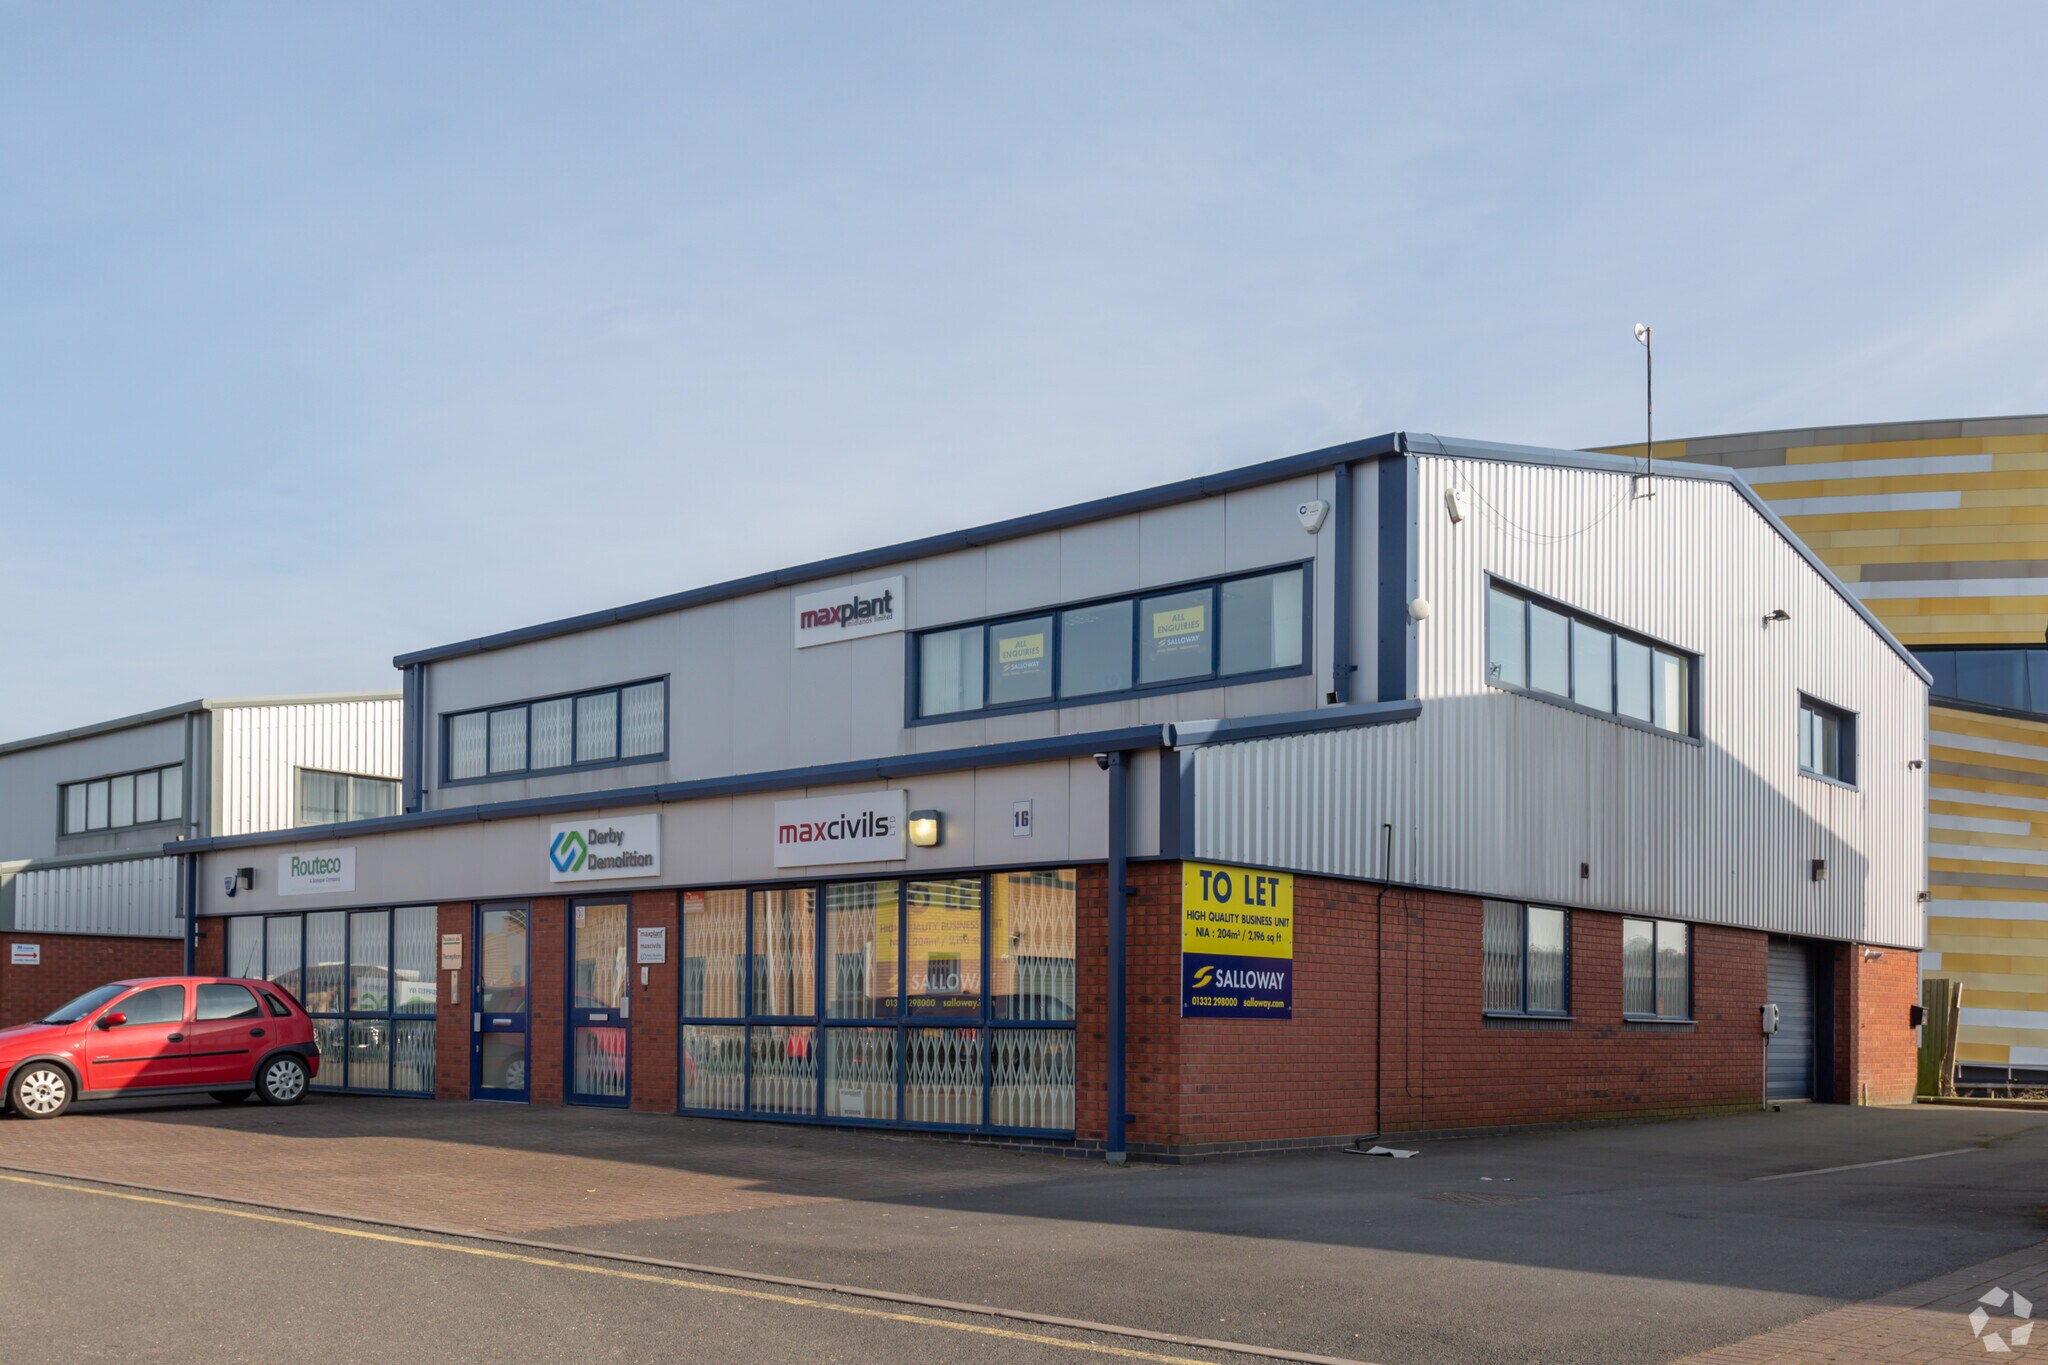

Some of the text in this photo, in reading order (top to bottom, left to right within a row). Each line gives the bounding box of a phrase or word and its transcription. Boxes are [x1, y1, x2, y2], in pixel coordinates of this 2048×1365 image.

[800, 589, 893, 629] maxplant
[1172, 613, 1185, 622] ALL
[847, 613, 893, 627] midlands limited
[1157, 620, 1200, 634] ENQUIRIES
[1015, 640, 1027, 649] ALL
[1167, 635, 1200, 646] SALLOWAY
[1003, 646, 1041, 659] ENQUIRIES
[1010, 660, 1040, 671] SALLOWAY
[778, 811, 889, 844] maxcivils
[1014, 811, 1029, 828] 16
[588, 827, 624, 846] Derby
[291, 856, 341, 877] Routeco
[588, 851, 653, 870] Demolition
[1200, 870, 1279, 907] TO LET
[1186, 910, 1290, 928] HIGH QUALITY BUSINESS UNIT
[1196, 927, 1210, 937] NIA
[1242, 929, 1246, 942] /
[1248, 931, 1265, 942] 2,196
[1267, 934, 1274, 944] sq
[1276, 931, 1282, 942] ft
[1215, 969, 1285, 990] SALLOWAY
[885, 999, 898, 1008] 013
[908, 998, 936, 1007] 298000
[1192, 996, 1284, 1011] 01332 298000 salloway.com
